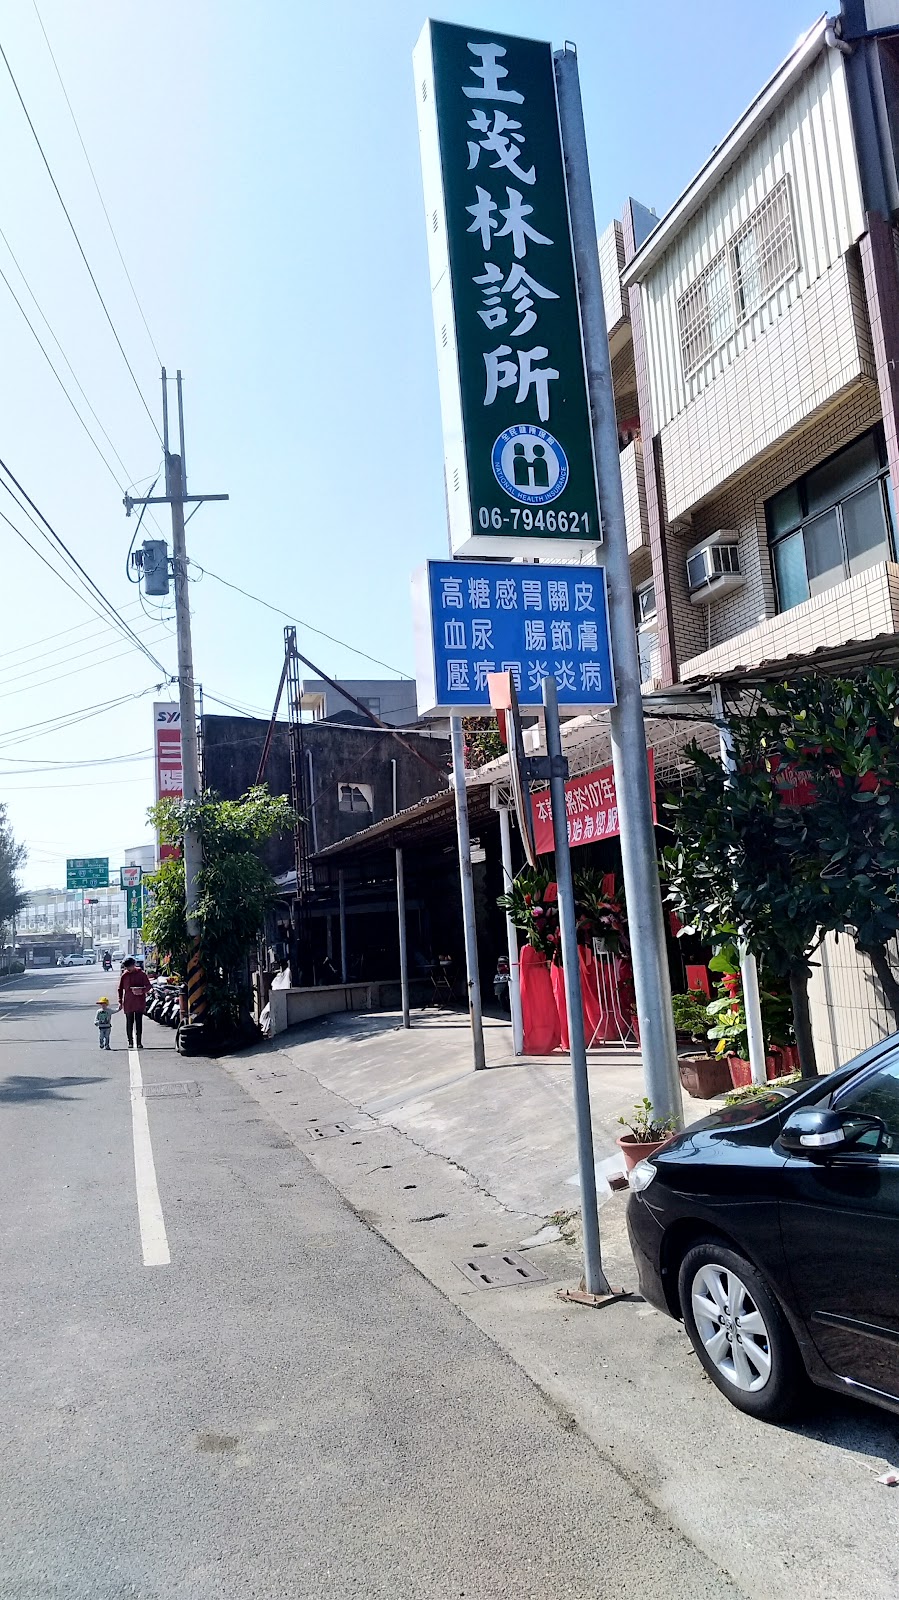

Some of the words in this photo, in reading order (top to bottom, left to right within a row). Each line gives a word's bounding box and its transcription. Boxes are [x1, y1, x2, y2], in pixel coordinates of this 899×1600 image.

[461, 41, 561, 422] 王茂林診所
[494, 461, 515, 496] NATIONAL
[517, 492, 544, 503] HEALTH
[545, 466, 567, 501] INSURANCE
[478, 506, 590, 533] 06-7946621
[440, 577, 469, 691] 高血壓
[574, 581, 602, 692] 皮膚病
[157, 711, 180, 723] SY
[567, 806, 620, 842] 始為您服
